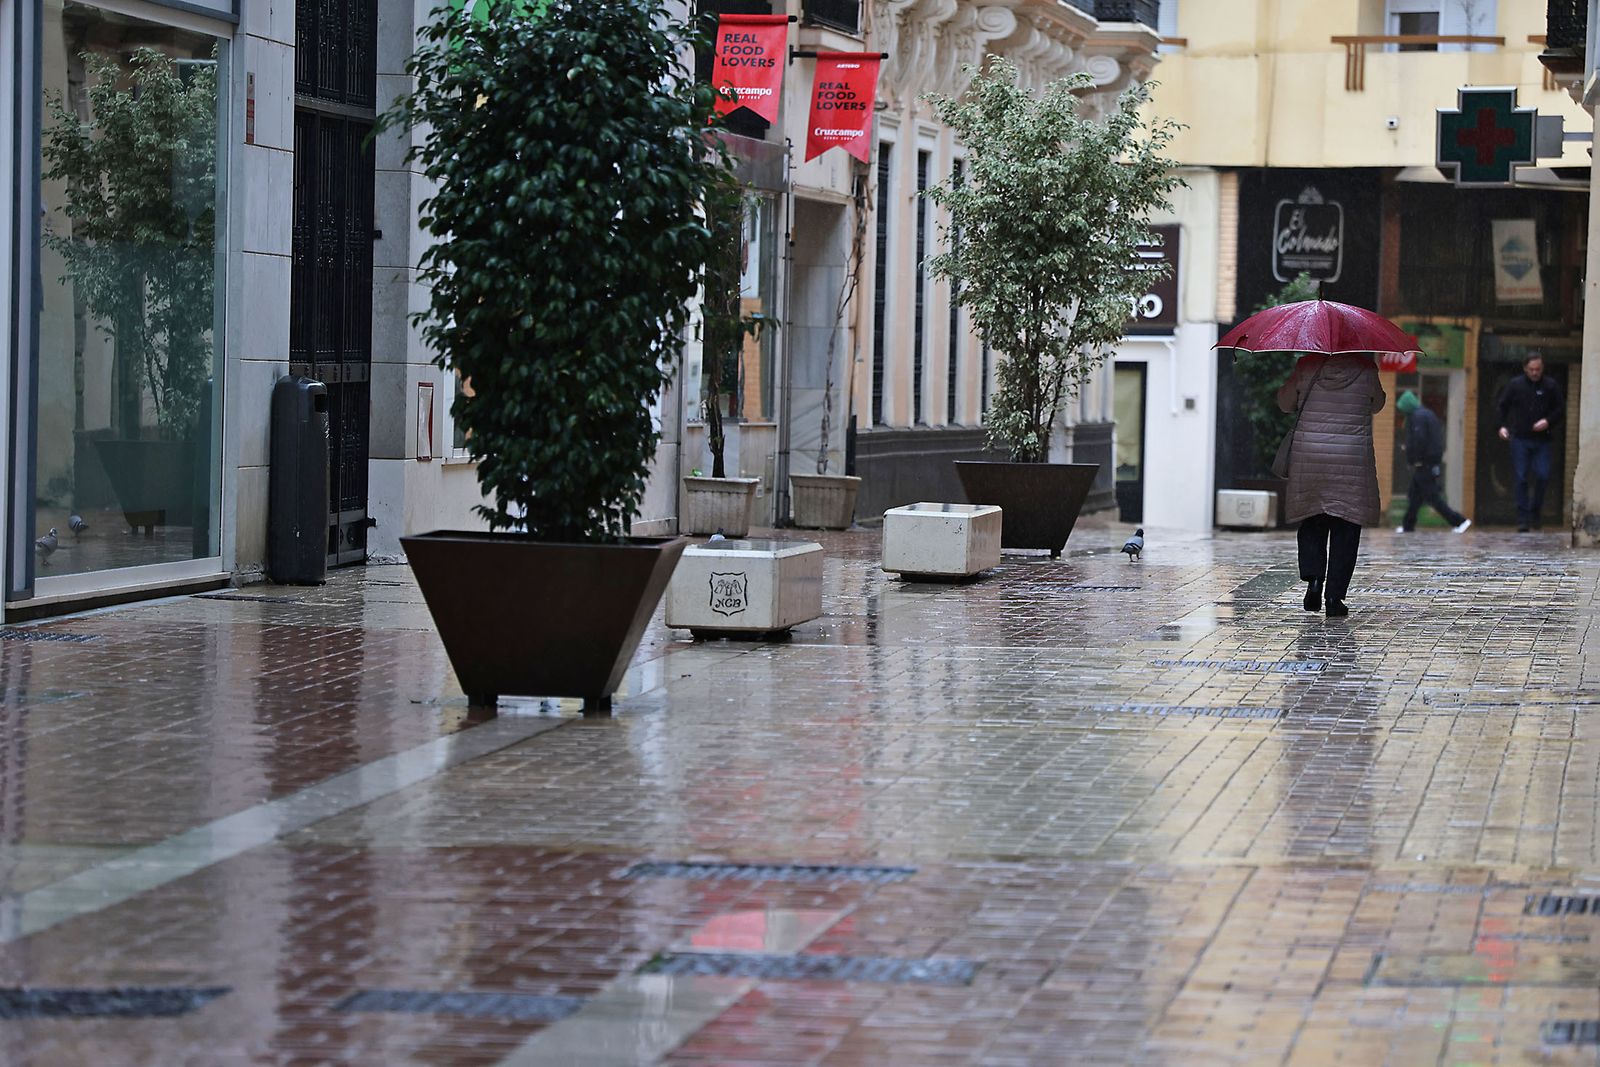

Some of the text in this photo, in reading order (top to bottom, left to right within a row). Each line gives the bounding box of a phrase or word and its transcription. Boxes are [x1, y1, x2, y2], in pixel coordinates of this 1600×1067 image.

[724, 33, 758, 44] REAL
[723, 45, 764, 56] FOOD
[721, 57, 776, 68] LOVERS
[719, 86, 772, 96] Crzcampo
[819, 82, 851, 90] REAL
[817, 91, 857, 100] FOOD
[816, 102, 867, 111] LOVERS
[814, 127, 865, 137] Cruzcampo
